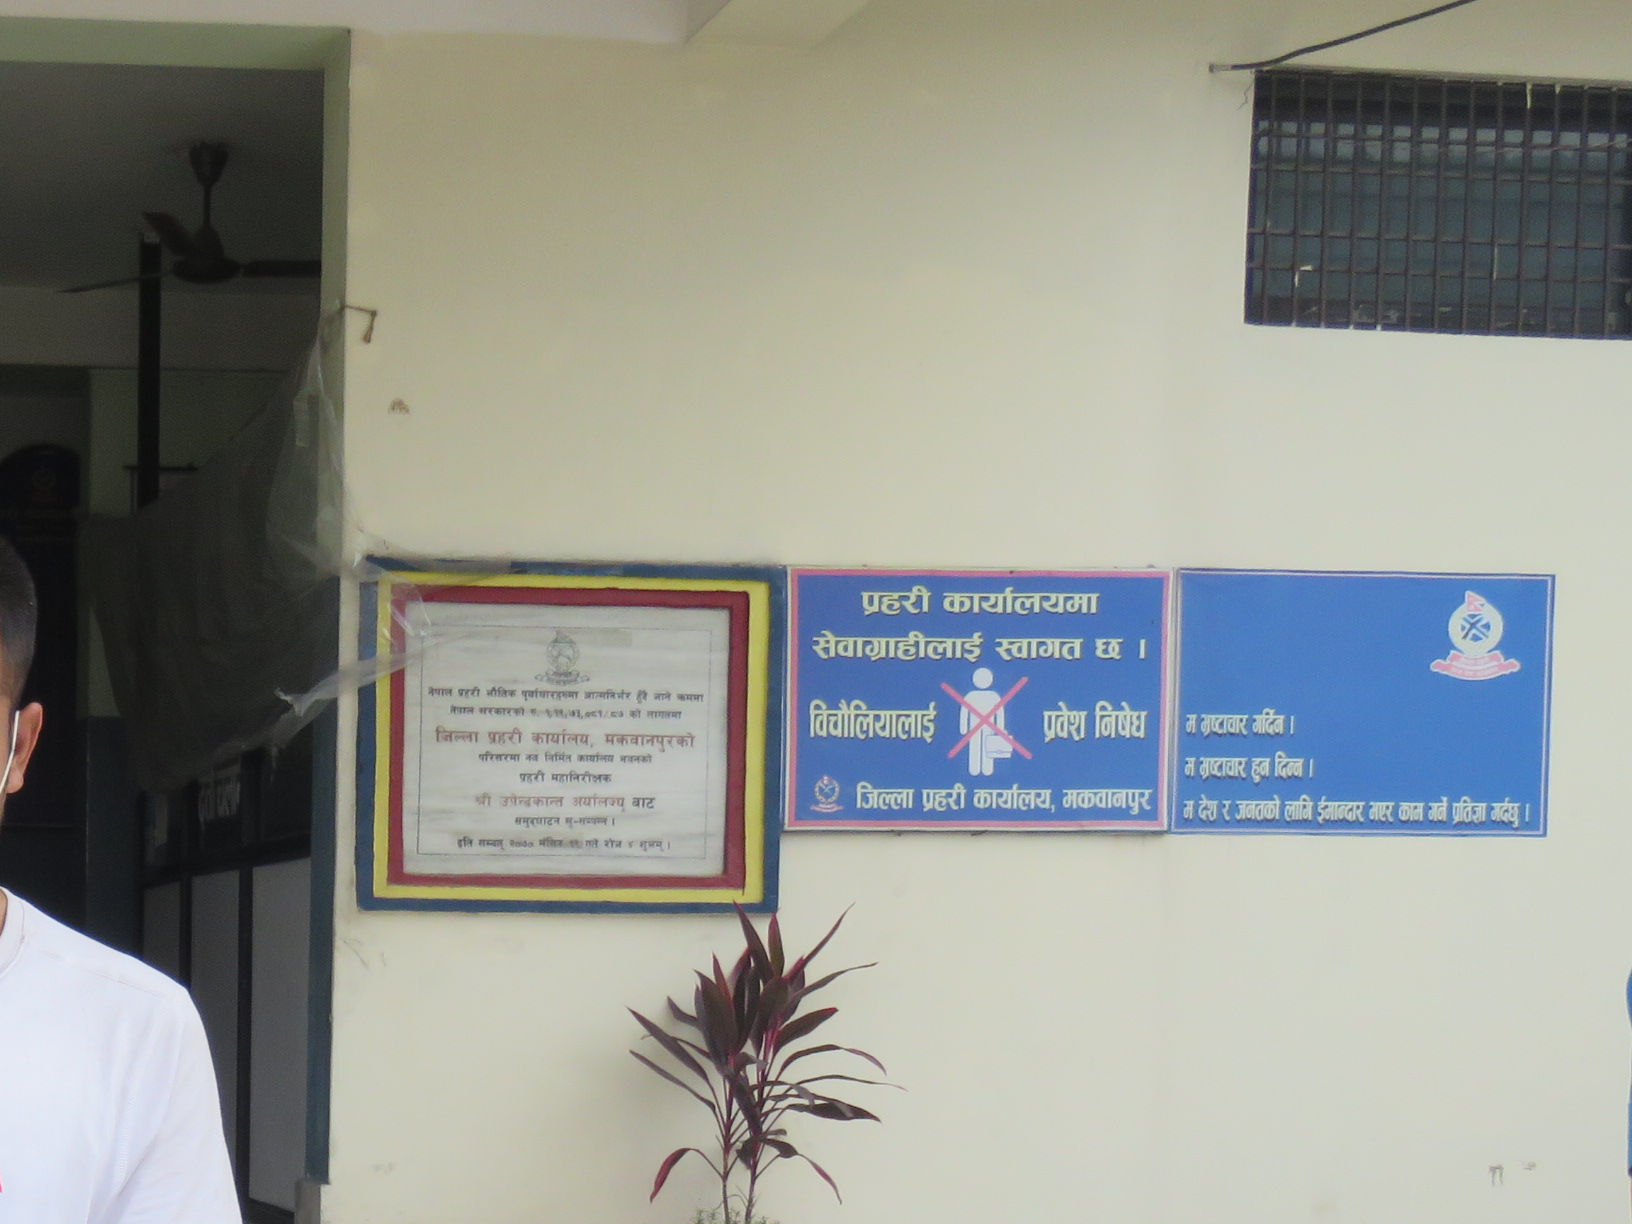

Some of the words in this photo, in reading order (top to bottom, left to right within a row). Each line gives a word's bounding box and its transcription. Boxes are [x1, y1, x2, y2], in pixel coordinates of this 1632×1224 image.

[861, 585, 932, 616] प्रहरी
[943, 587, 1100, 615] कार्यालयमा
[812, 630, 984, 662] सेवाग्राहीलाई
[995, 638, 1083, 661] स्वागत
[1095, 638, 1123, 660] छ
[809, 699, 937, 744] विचौलियालाई
[1043, 701, 1088, 743] प्रवेश
[1095, 700, 1148, 739] निषेध
[1185, 714, 1197, 735] म
[1200, 713, 1249, 737] भ्रष्टाचार
[435, 725, 480, 743] जिल्ला
[487, 726, 523, 745] प्रहरी
[604, 732, 696, 753] मकवानपुरको
[519, 769, 545, 783] प्रहरी
[1184, 757, 1196, 777] म
[1199, 757, 1248, 779] भ्रष्टाचार
[1251, 757, 1271, 784] हुन
[856, 781, 915, 810] जिल्ला
[921, 783, 967, 812] प्रहरी
[973, 783, 1055, 813] कार्यालय,
[1062, 788, 1153, 816] मकवानपुर
[1183, 800, 1194, 819] म
[1198, 793, 1218, 822] देश
[1221, 800, 1232, 821] र
[1398, 801, 1425, 822] काम
